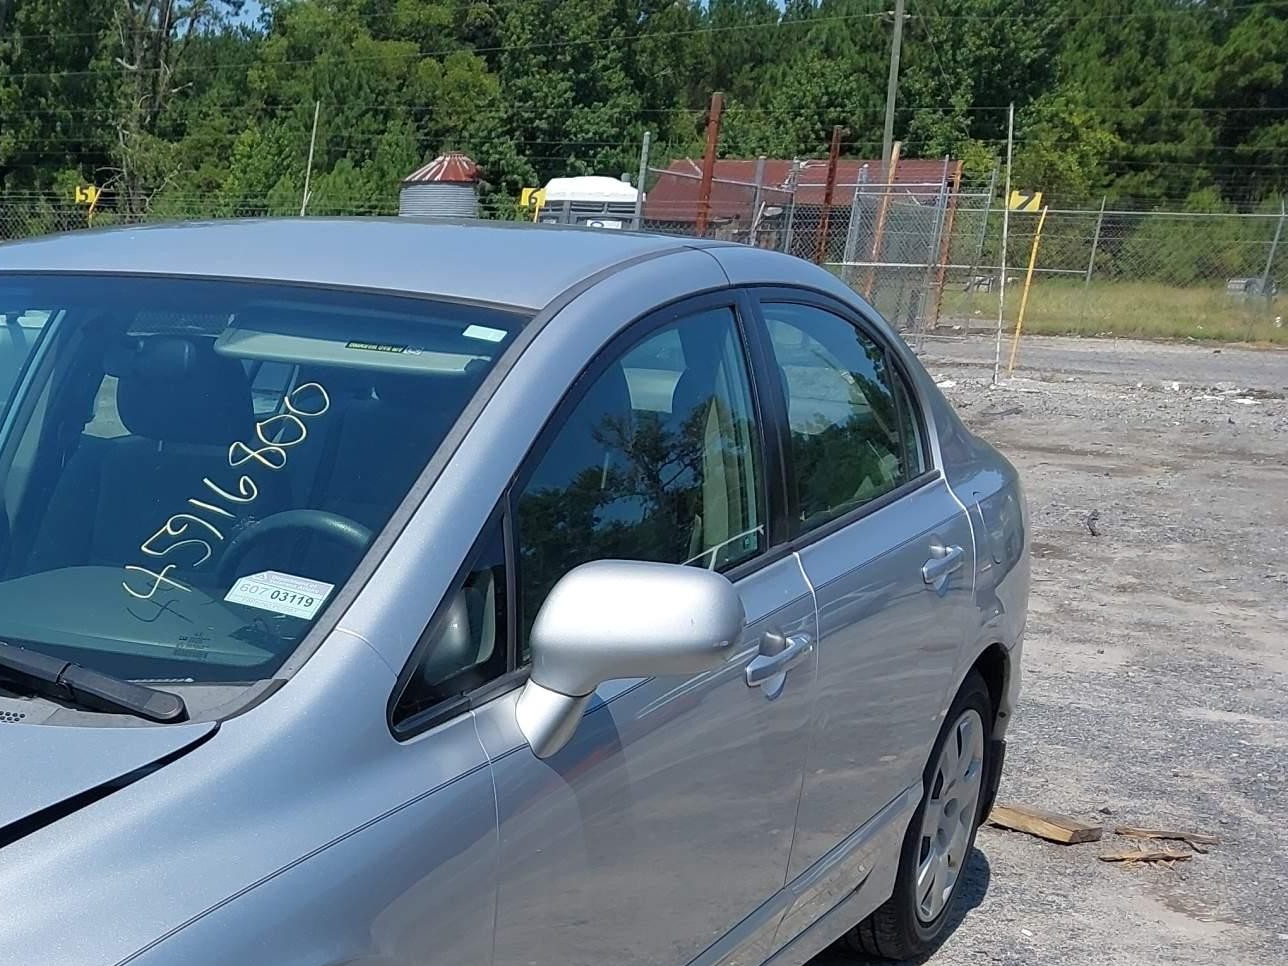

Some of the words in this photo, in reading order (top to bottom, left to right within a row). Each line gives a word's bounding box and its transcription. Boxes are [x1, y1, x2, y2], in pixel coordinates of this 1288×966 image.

[78, 186, 89, 203] 5
[528, 187, 541, 210] 6
[1015, 190, 1036, 210] 7
[122, 382, 330, 599] 45916800
[270, 590, 314, 608] 03119
